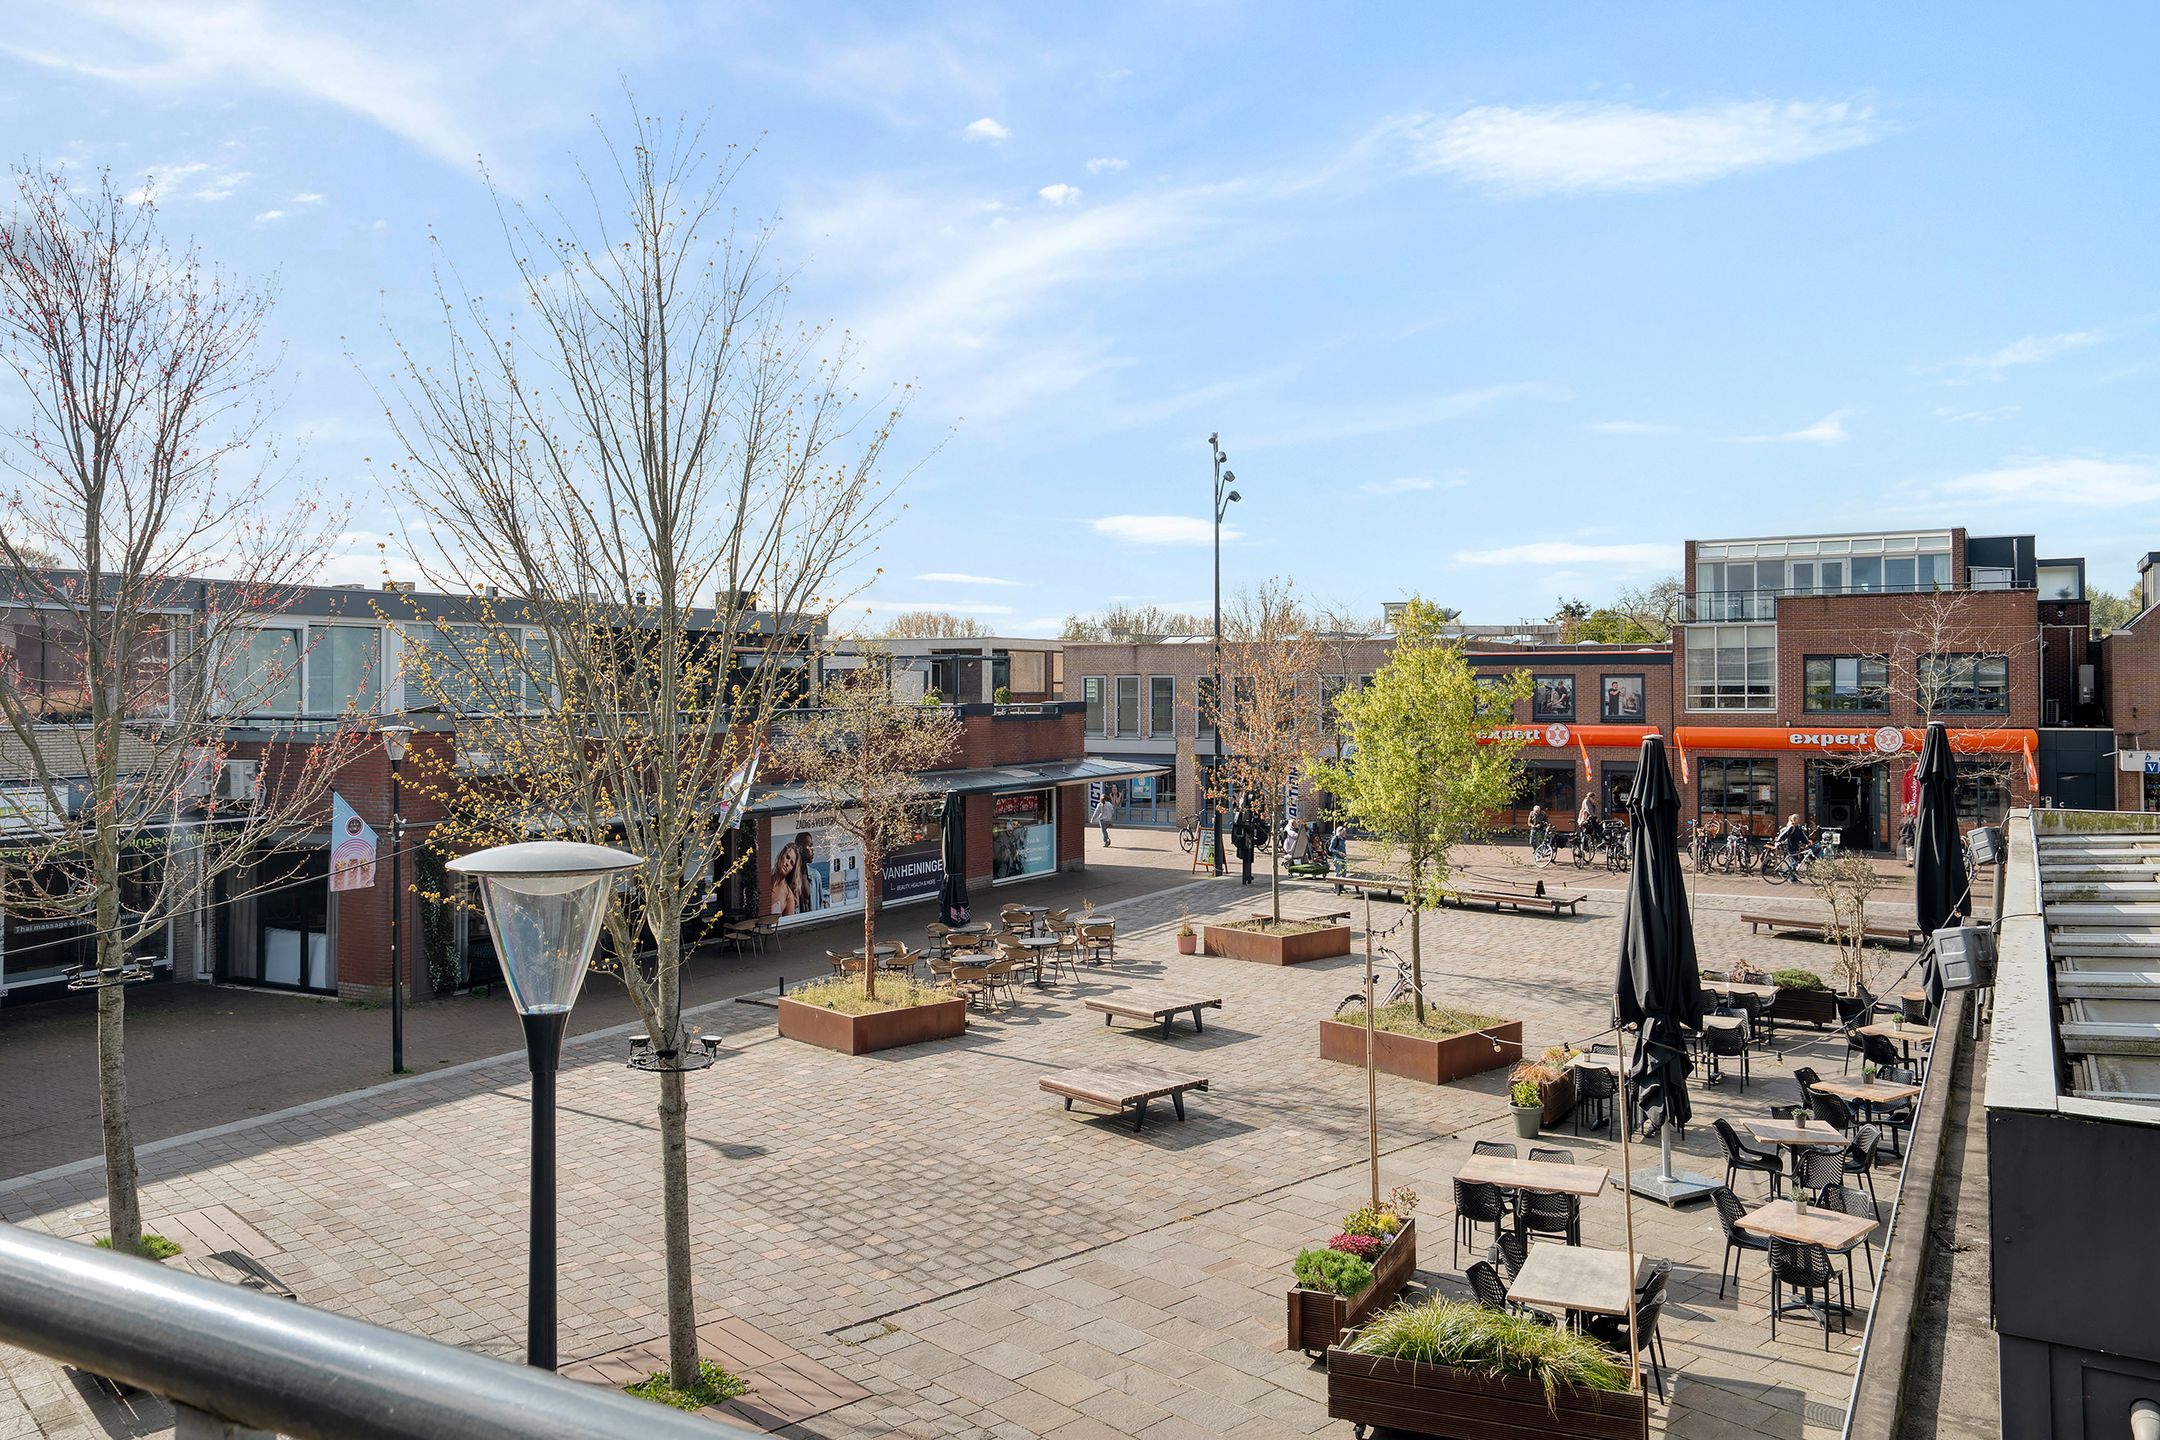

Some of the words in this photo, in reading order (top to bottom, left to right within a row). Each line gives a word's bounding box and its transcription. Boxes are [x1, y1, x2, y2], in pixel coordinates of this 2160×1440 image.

[1477, 729, 1541, 741] expert
[1789, 733, 1868, 746] expert
[1090, 781, 1101, 810] ACT
[881, 859, 943, 880] VANHEININGE
[15, 925, 33, 933] Thai
[33, 921, 68, 931] massage
